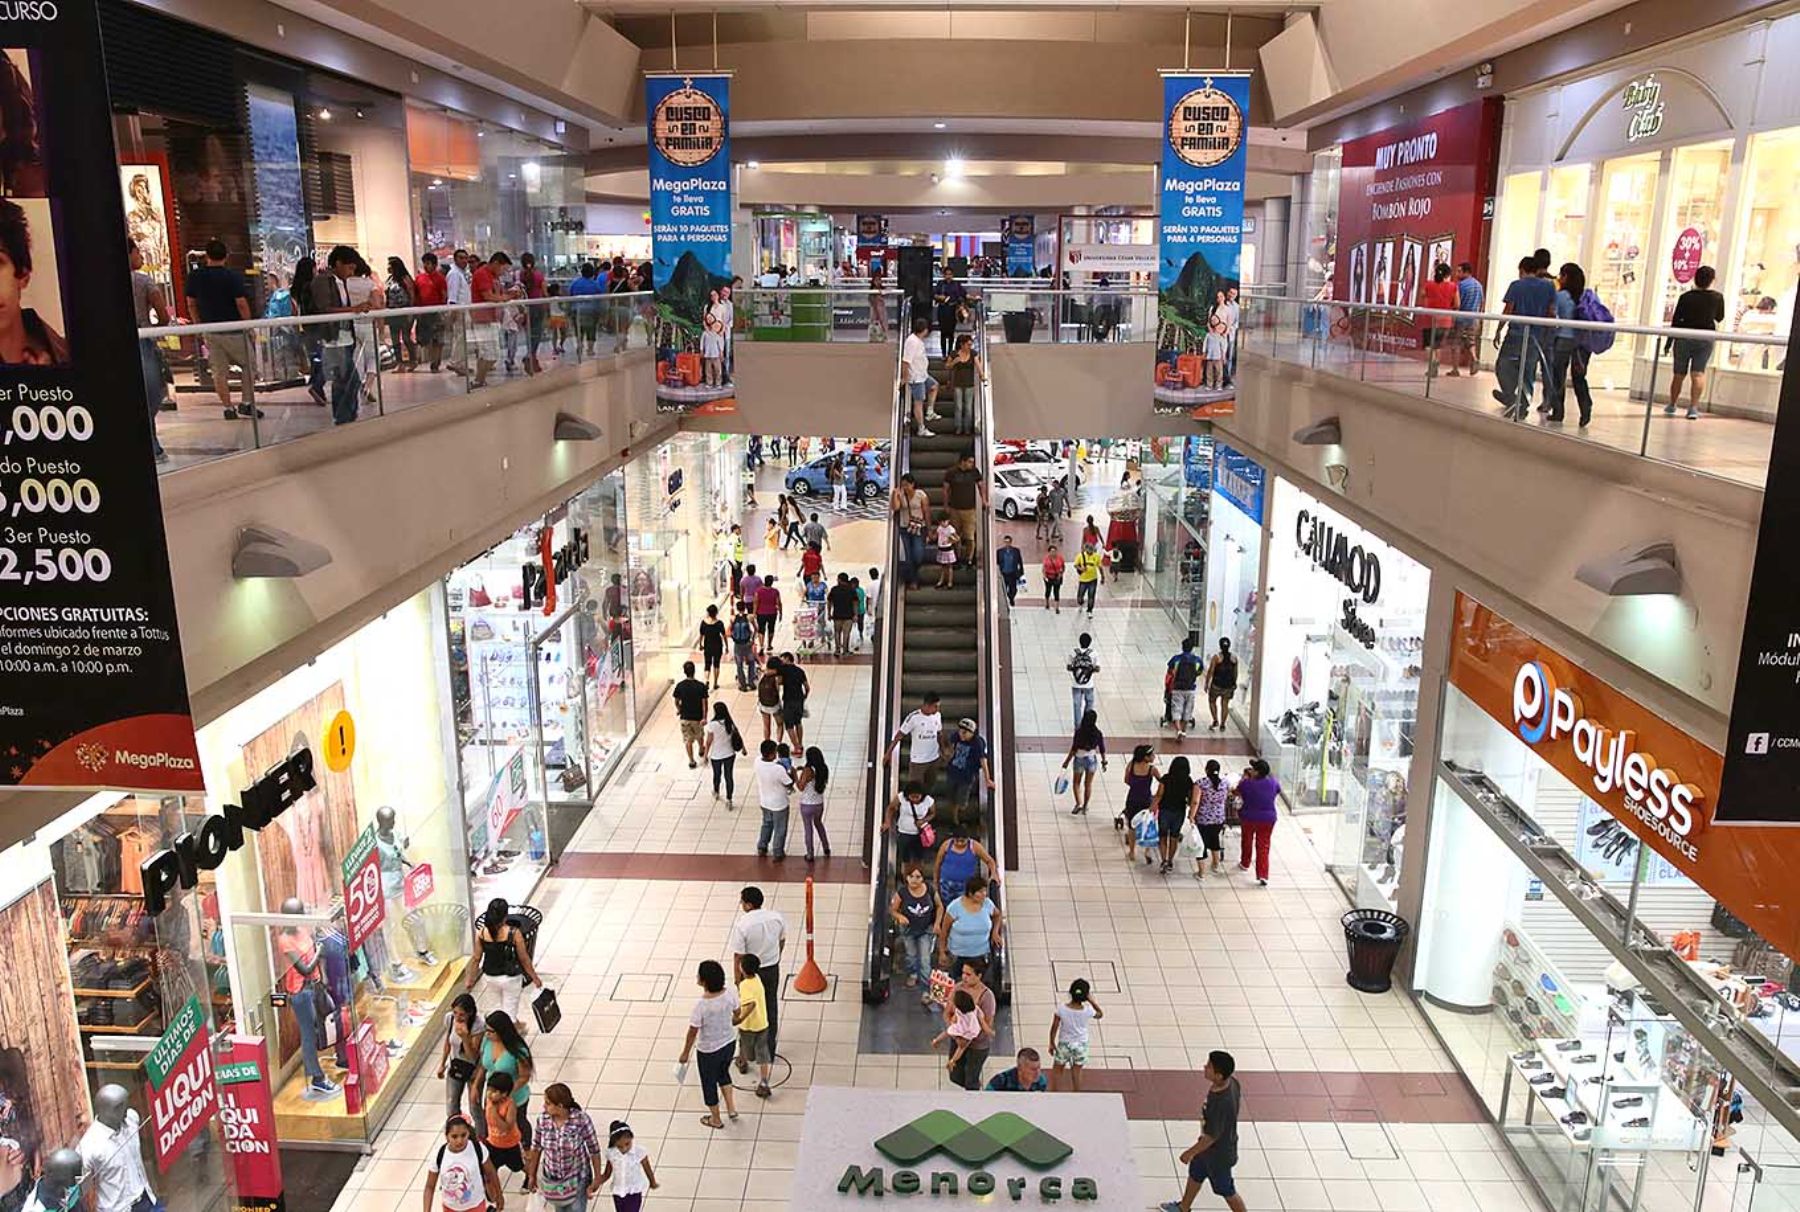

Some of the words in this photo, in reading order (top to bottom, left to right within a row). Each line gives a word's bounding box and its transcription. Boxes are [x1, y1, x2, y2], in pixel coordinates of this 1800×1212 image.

[666, 107, 711, 121] CUSCO
[1183, 107, 1229, 121] CUSCO
[1375, 143, 1397, 170] MUY
[1397, 132, 1438, 166] PRONTO
[653, 179, 726, 193] MegaPlaza
[1165, 179, 1240, 193] MegaPlaza
[1426, 171, 1443, 186] CON
[671, 206, 710, 216] GRATIS
[1182, 206, 1222, 217] GRATIS
[1408, 197, 1431, 217] ROJO
[690, 225, 729, 233] PAQUETES
[1679, 236, 1700, 250] 30%
[18, 384, 73, 401] Puesto
[26, 457, 81, 474] Puesto
[5, 527, 32, 544] 3er
[38, 528, 91, 544] Puesto
[0, 547, 112, 585] 2,500
[61, 607, 149, 622] GRATUITAS:
[44, 626, 90, 639] ubicado
[92, 627, 128, 640] frente
[130, 631, 138, 639] a
[140, 626, 170, 641] Tottus
[1, 642, 12, 656] el
[14, 642, 70, 659] domingo
[73, 645, 80, 656] 2
[83, 643, 100, 656] de
[102, 648, 142, 656] marzo
[33, 662, 59, 672] a.m.
[61, 665, 68, 673] a
[72, 660, 103, 673] 10:00
[106, 665, 133, 676] p.m.
[115, 750, 194, 770] MegaPlaza
[1551, 686, 1696, 836] Payless
[1623, 794, 1699, 863] SHOESOURCE
[154, 1005, 194, 1065] ULTIMOS
[160, 1041, 183, 1076] DIAS
[183, 1022, 197, 1044] DE
[244, 1066, 258, 1076] DE
[154, 1048, 212, 1130] LIQUI
[217, 1093, 235, 1109] LI
[160, 1082, 214, 1156] DACION
[220, 1108, 259, 1124] QUI
[224, 1124, 255, 1139] DA
[837, 1164, 1098, 1201] Menorca
